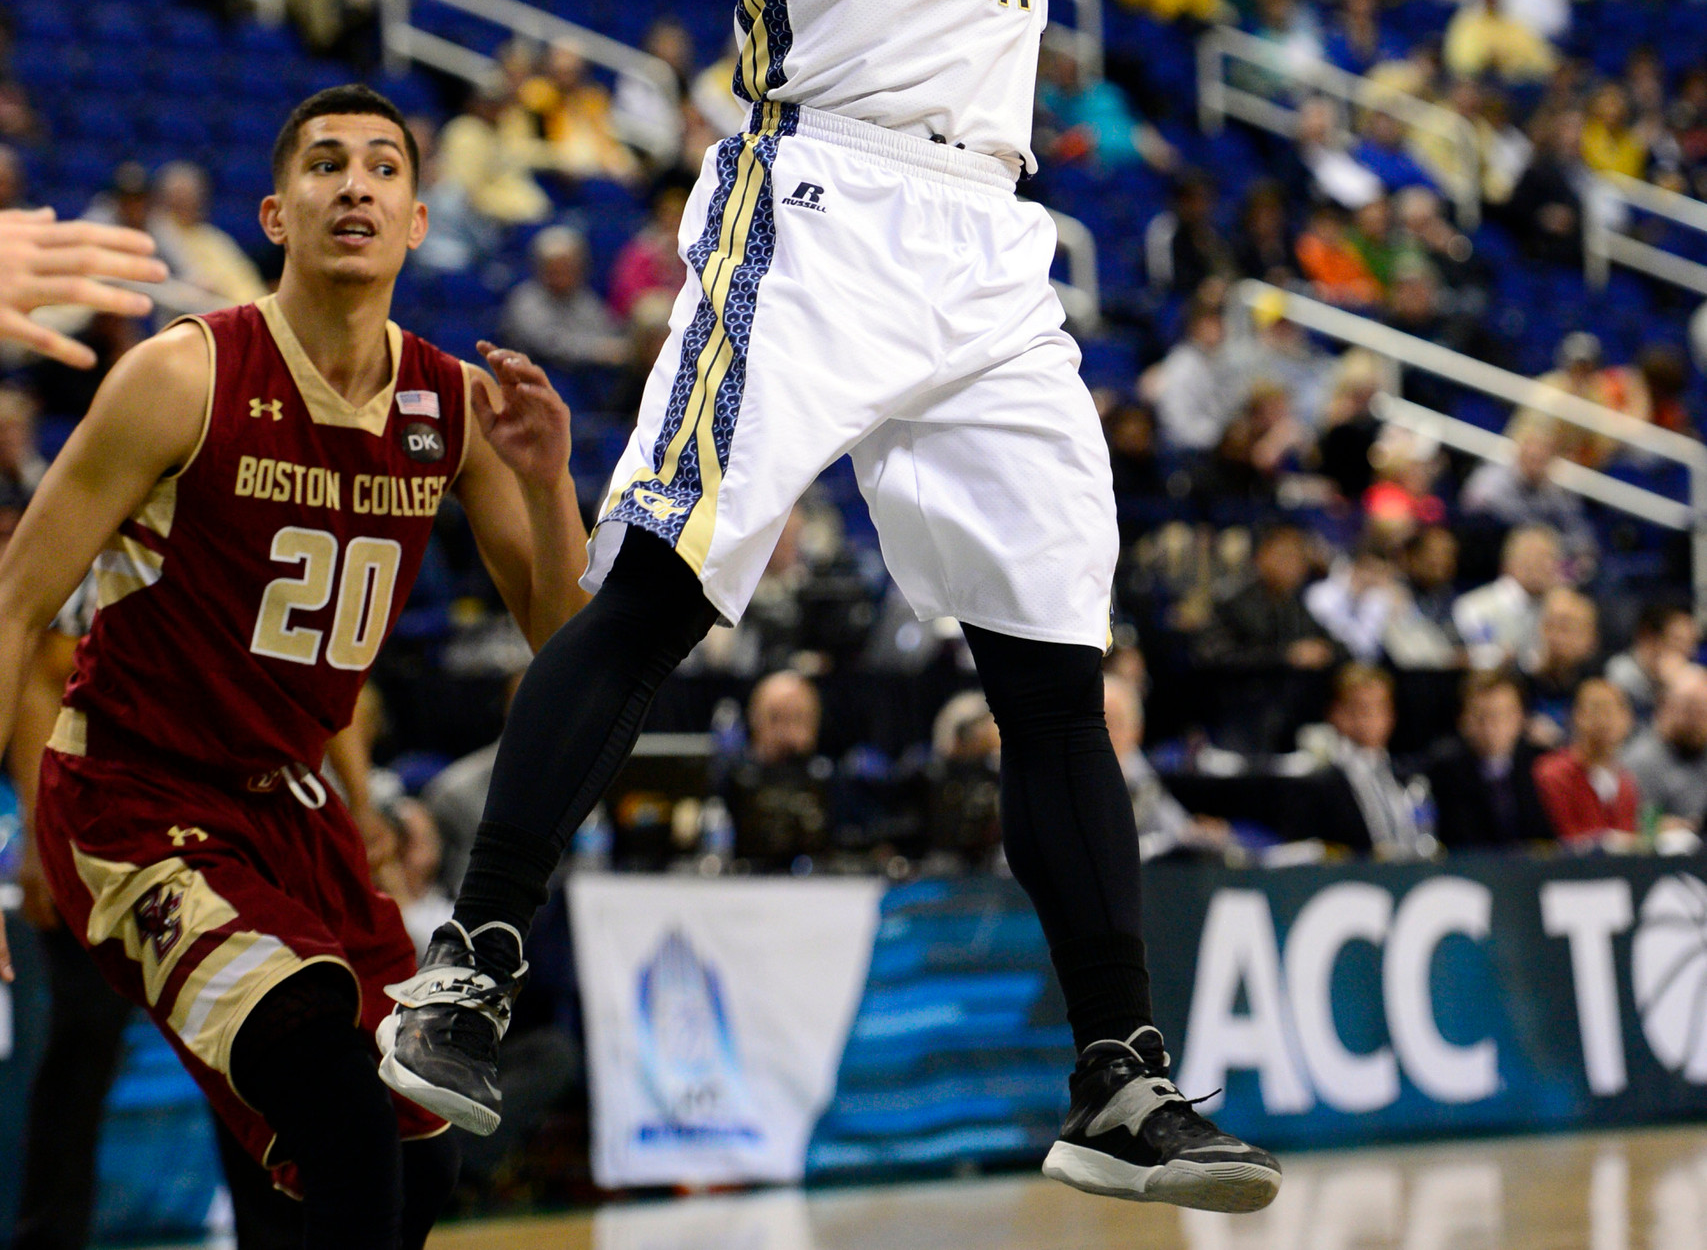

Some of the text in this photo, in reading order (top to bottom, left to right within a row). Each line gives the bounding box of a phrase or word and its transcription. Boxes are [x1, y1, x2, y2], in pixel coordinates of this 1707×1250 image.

[781, 197, 827, 214] RUSSELL
[408, 432, 440, 452] DK
[235, 455, 341, 511] BOSTON
[250, 526, 402, 672] 20
[1174, 875, 1502, 1117] ACC
